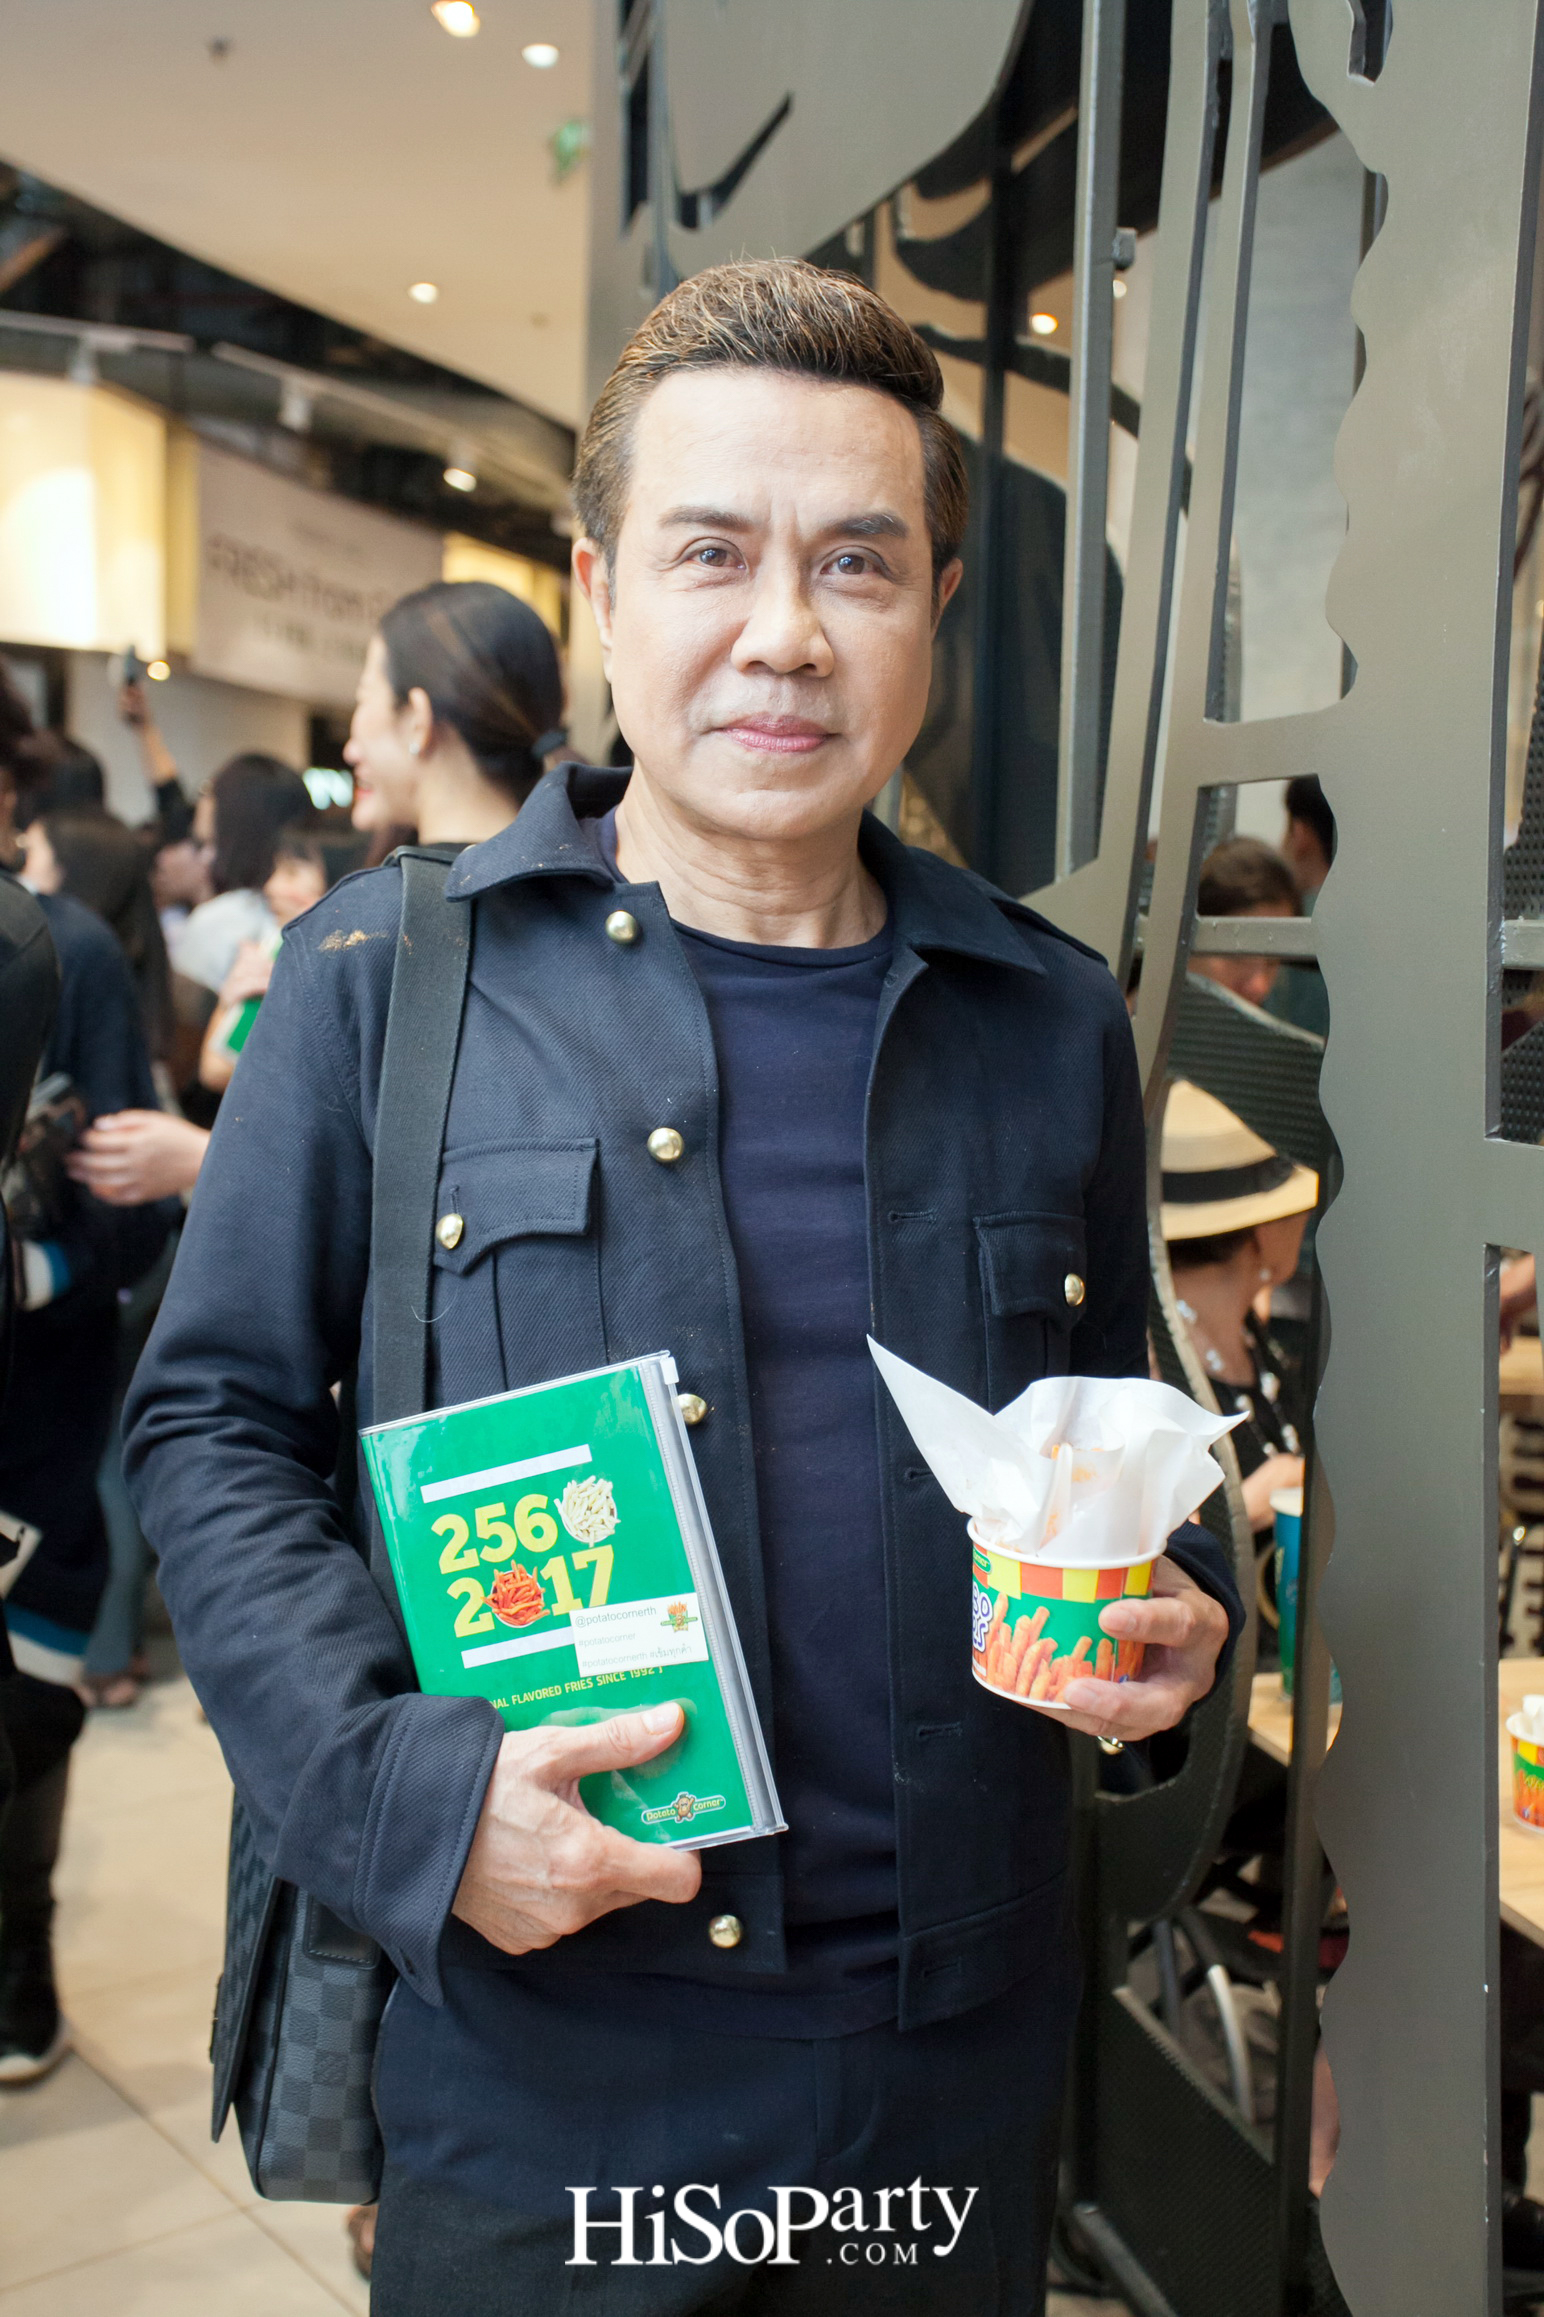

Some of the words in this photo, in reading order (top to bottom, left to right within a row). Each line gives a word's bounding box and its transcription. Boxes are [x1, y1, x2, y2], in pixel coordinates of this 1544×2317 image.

[575, 1606, 657, 1628] @potatocornerth
[578, 1632, 636, 1648] #potatocorner
[582, 1651, 648, 1669] #potatocornerth
[511, 1685, 563, 1706] FLAVORED
[565, 1677, 594, 1694] FRIES
[596, 1671, 627, 1686] SINCE
